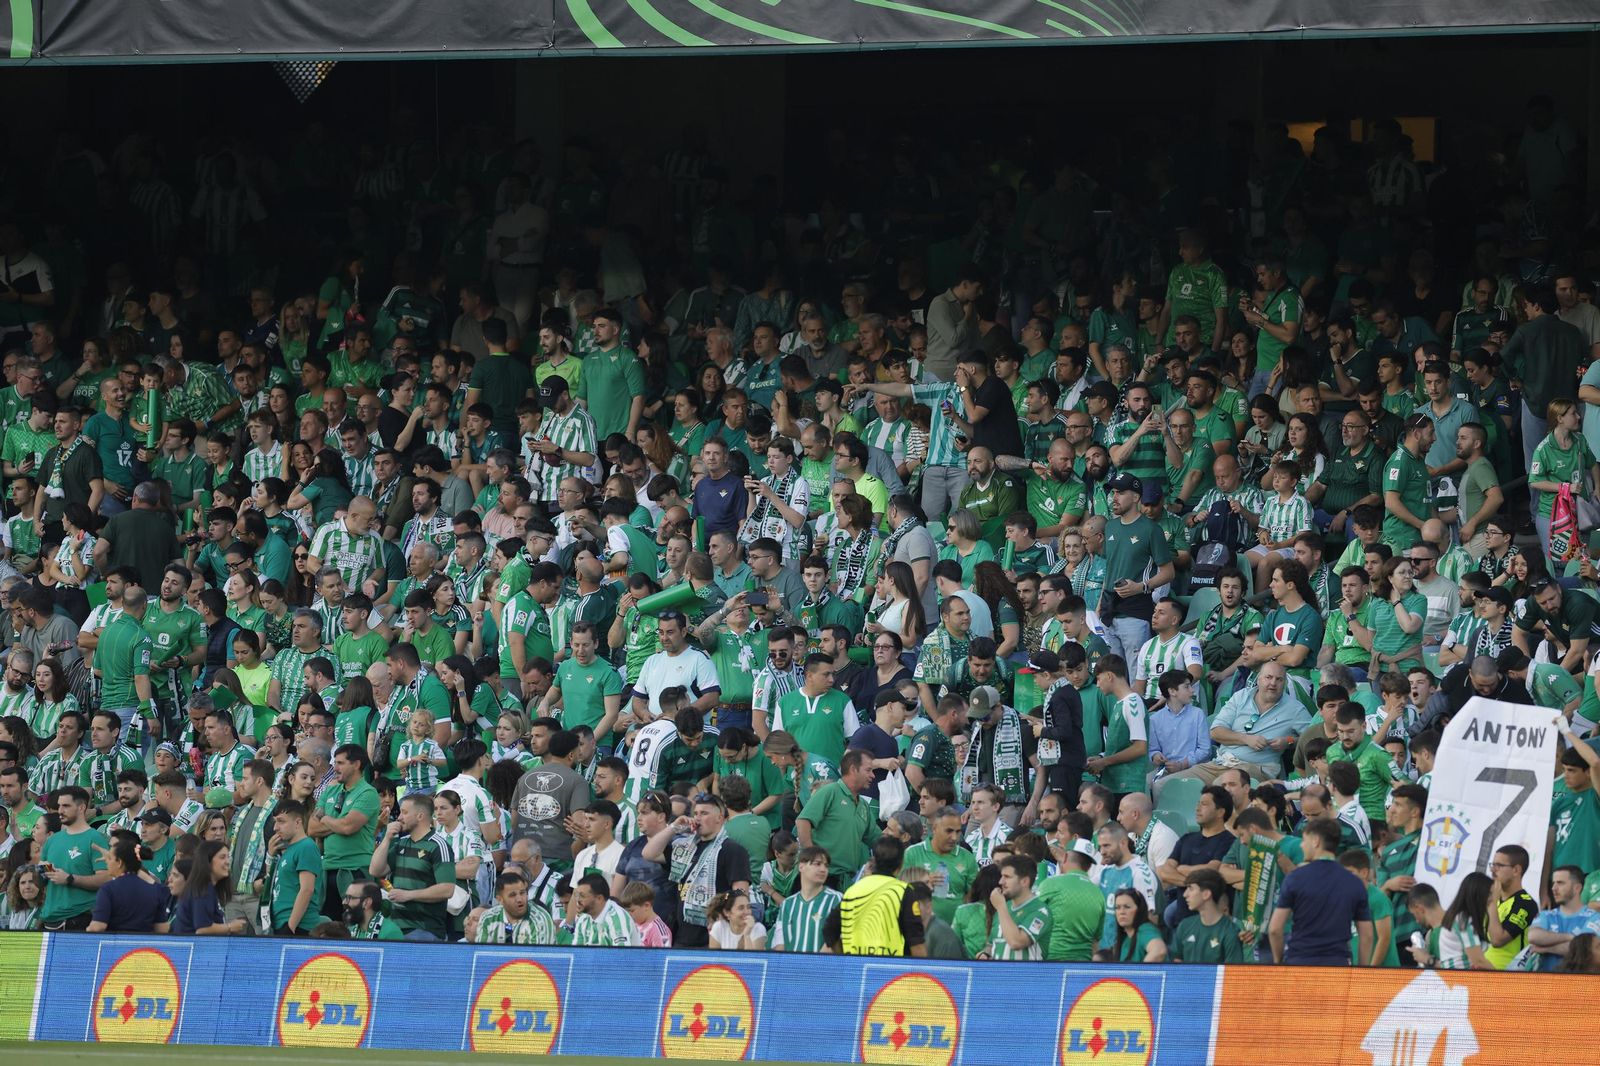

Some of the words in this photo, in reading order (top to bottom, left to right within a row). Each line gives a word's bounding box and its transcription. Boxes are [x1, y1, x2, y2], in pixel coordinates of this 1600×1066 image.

[1190, 576, 1216, 585] FORTNITE
[1462, 717, 1547, 749] ANTONY
[633, 737, 652, 767] 8
[1475, 767, 1539, 874] 7
